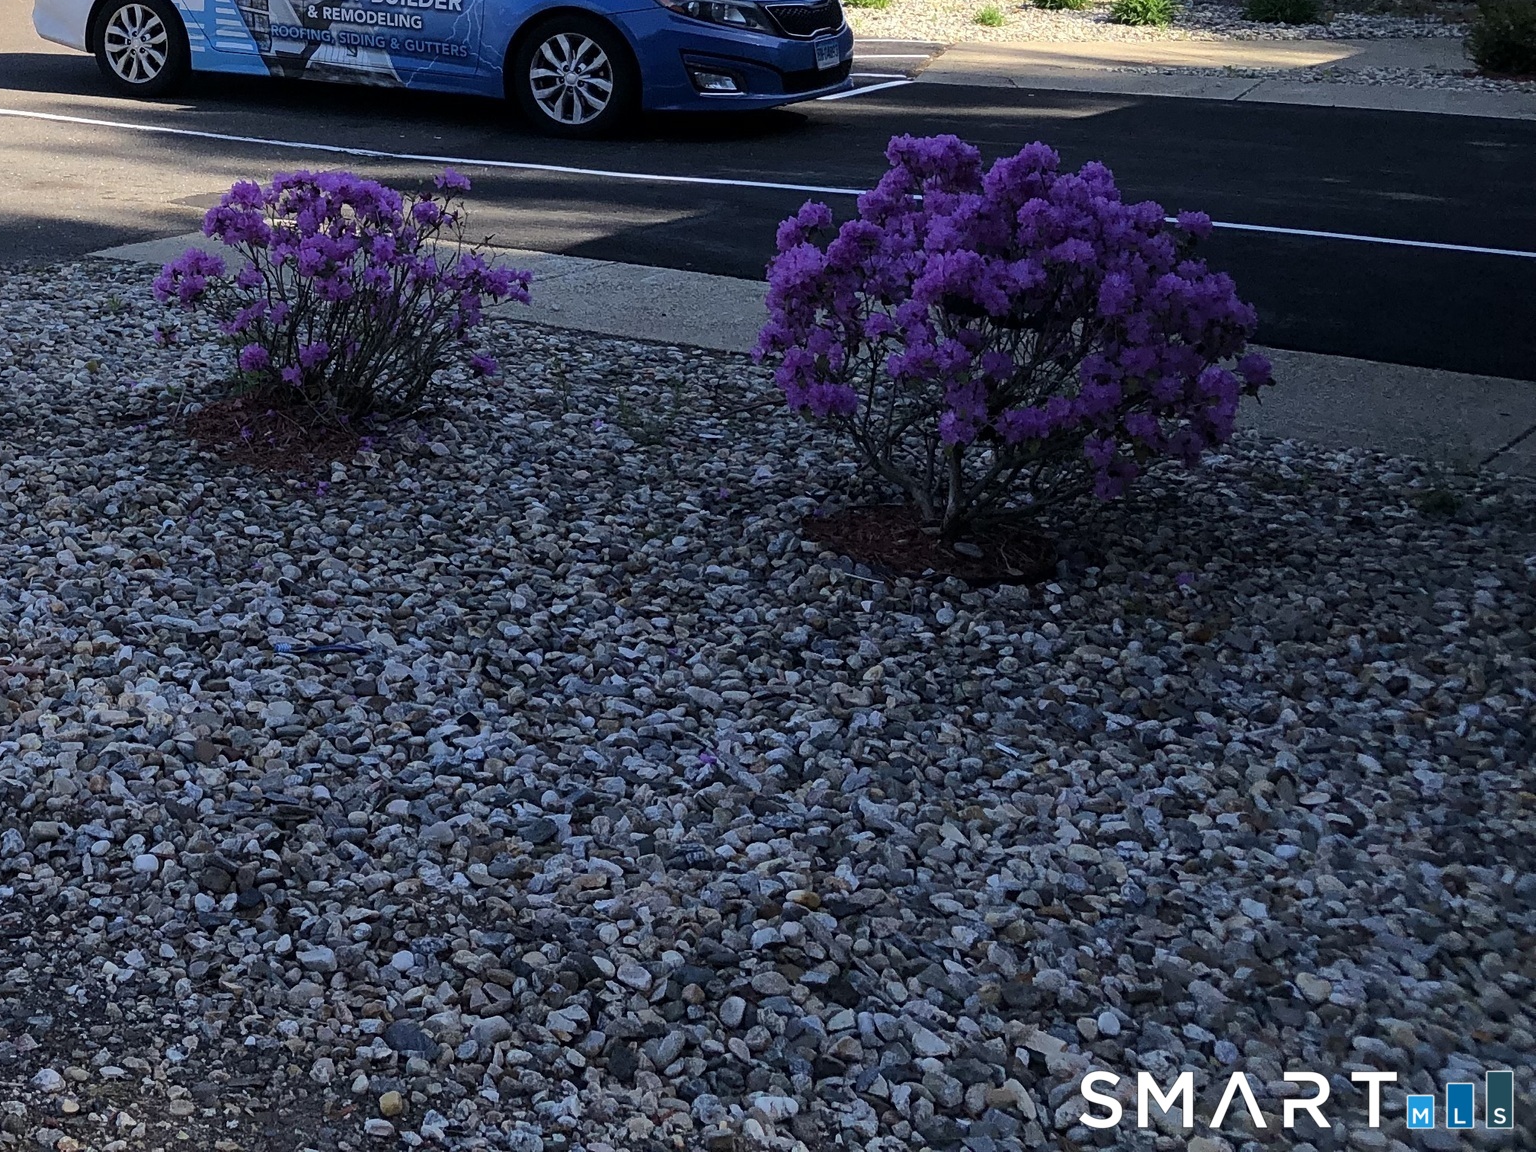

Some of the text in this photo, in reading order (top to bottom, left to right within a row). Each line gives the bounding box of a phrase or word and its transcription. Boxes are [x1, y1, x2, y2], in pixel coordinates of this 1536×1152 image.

[307, 5, 423, 29] & REMODELING
[270, 24, 468, 57] ROOFING, SIDING & GUTTERS
